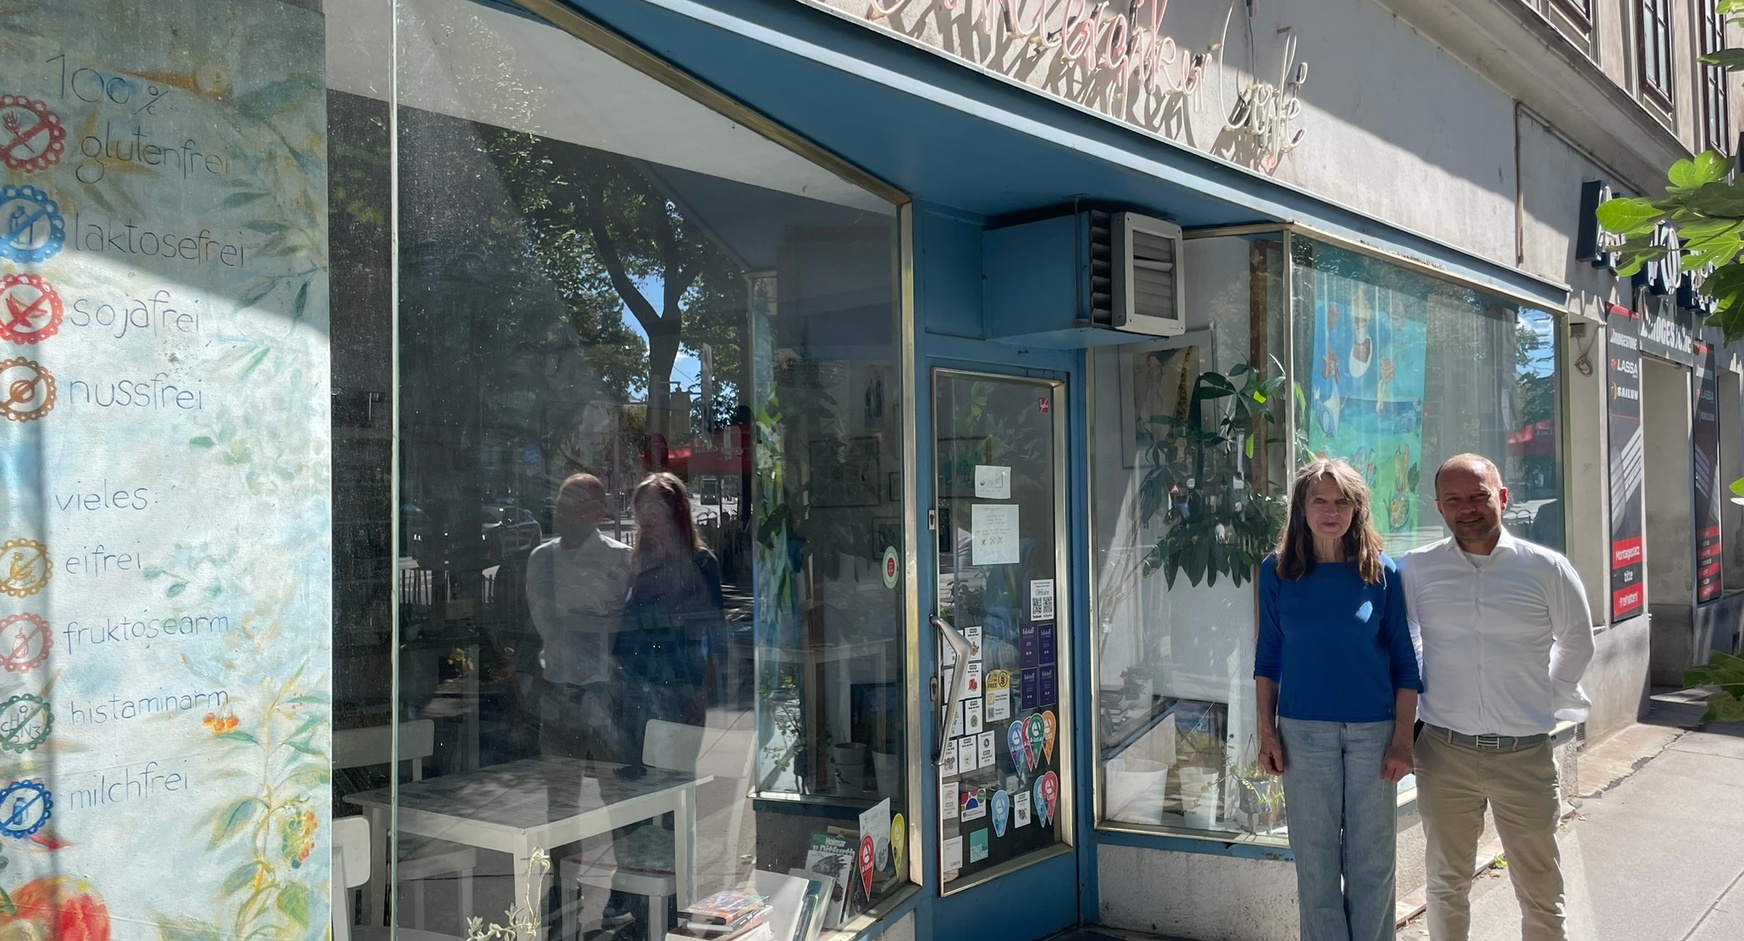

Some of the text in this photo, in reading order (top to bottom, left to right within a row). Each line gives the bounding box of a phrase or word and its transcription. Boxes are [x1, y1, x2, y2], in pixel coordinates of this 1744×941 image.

[75, 122, 231, 184] glutenfrei
[74, 212, 245, 268] laktosefrei
[70, 289, 200, 339] sojafrei
[1617, 359, 1638, 377] LASSA
[69, 373, 203, 412] nussfrei
[55, 479, 159, 513] vieles:
[64, 542, 142, 576] eifrei
[63, 614, 229, 655] fruktosearm
[70, 688, 229, 727] histaminarm
[69, 761, 189, 811] milchfrei
